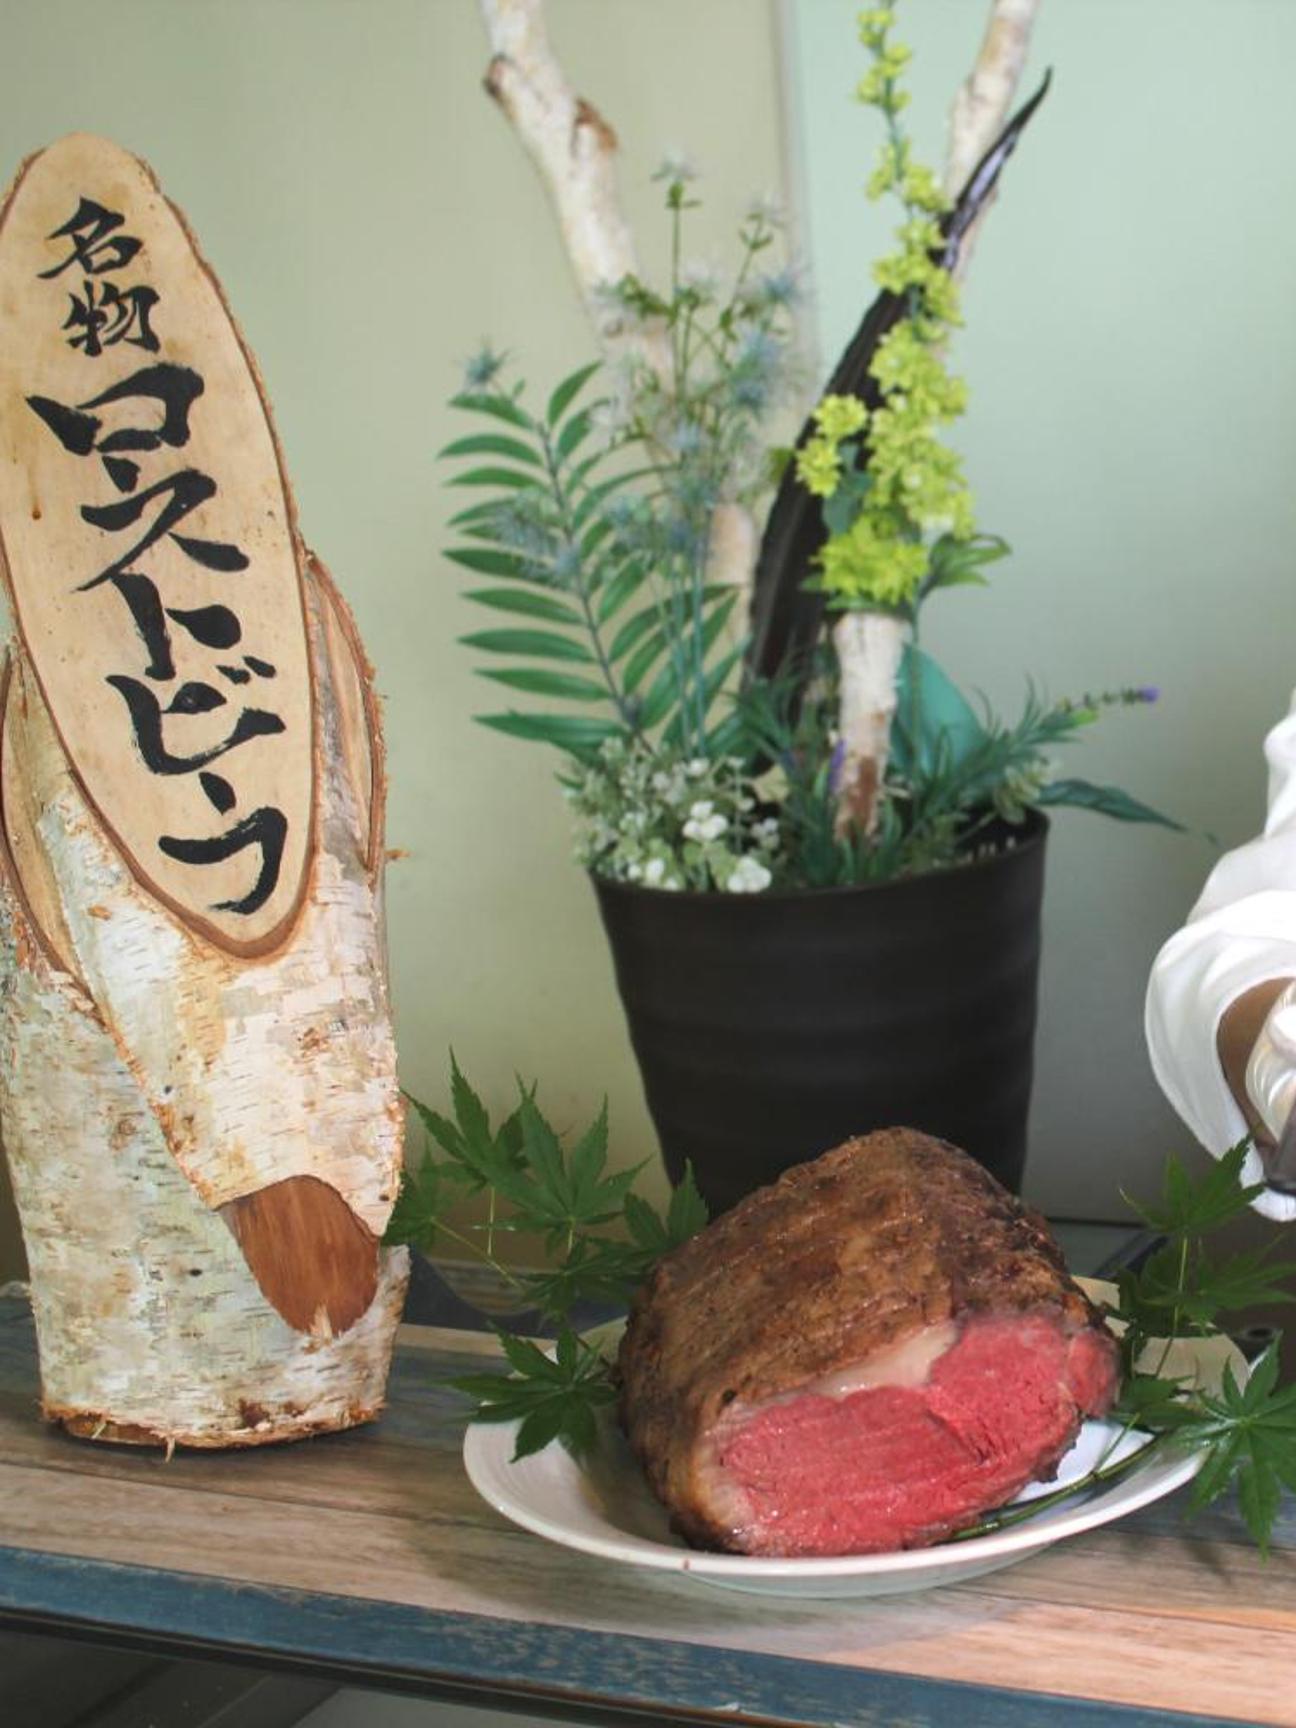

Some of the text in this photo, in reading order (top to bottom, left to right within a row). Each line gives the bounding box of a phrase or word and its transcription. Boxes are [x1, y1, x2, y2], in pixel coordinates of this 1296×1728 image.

[25, 196, 288, 916] 名物 ローストビーフ
